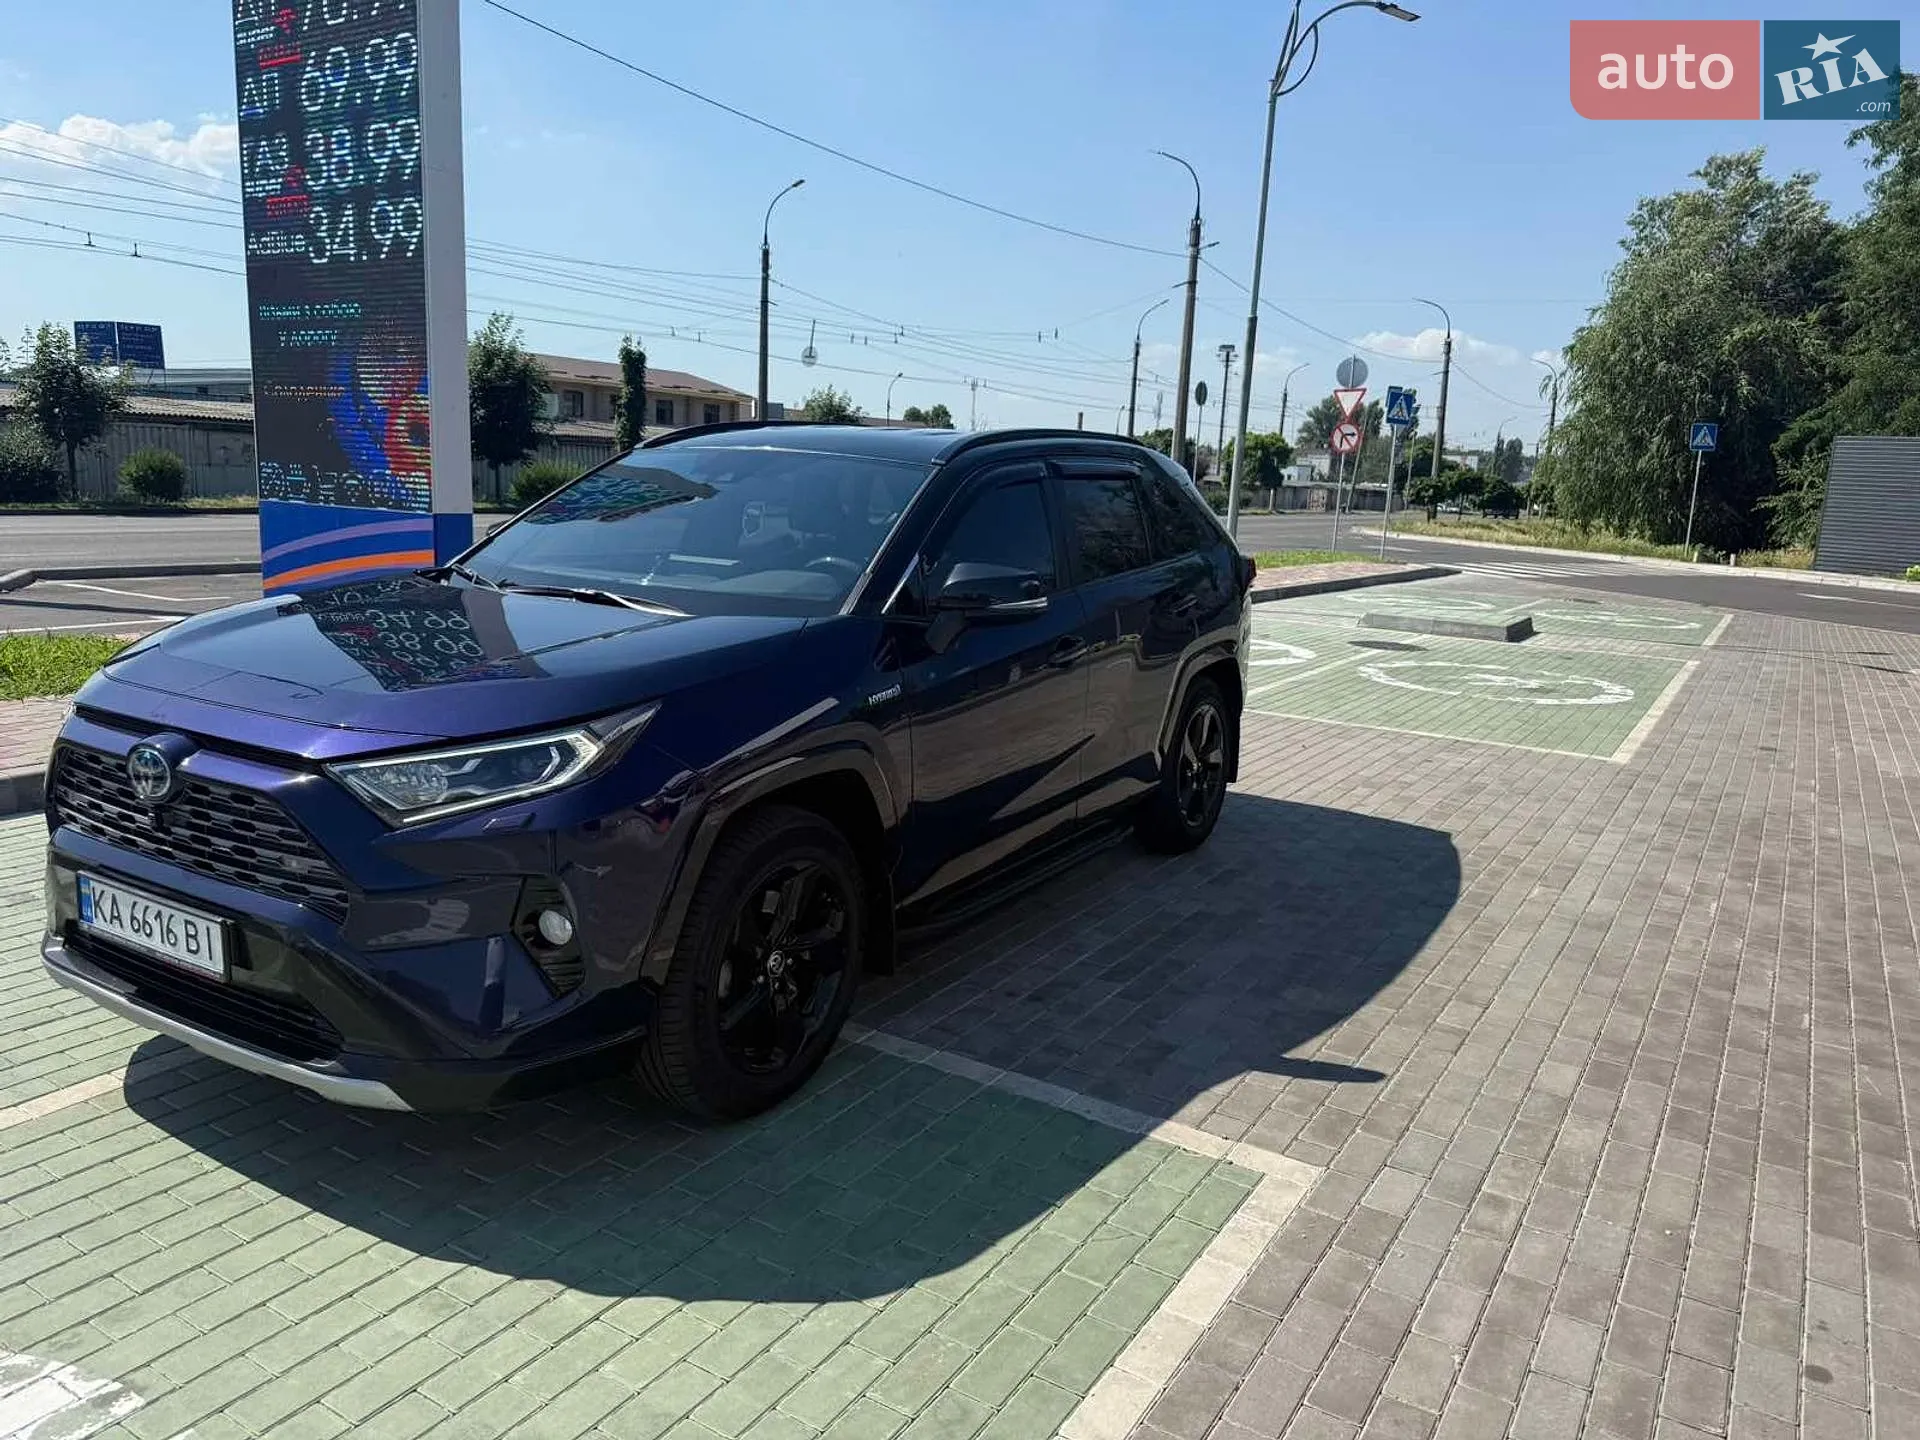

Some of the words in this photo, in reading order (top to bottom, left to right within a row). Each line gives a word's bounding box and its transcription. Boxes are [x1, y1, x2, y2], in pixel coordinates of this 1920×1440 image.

[300, 32, 418, 111] 69.99
[242, 132, 289, 174] ГАЗ
[304, 117, 421, 190] 38.99
[308, 196, 423, 264] 34.99
[92, 886, 124, 929] KA
[130, 900, 178, 947] 6616
[184, 919, 213, 961] BI
